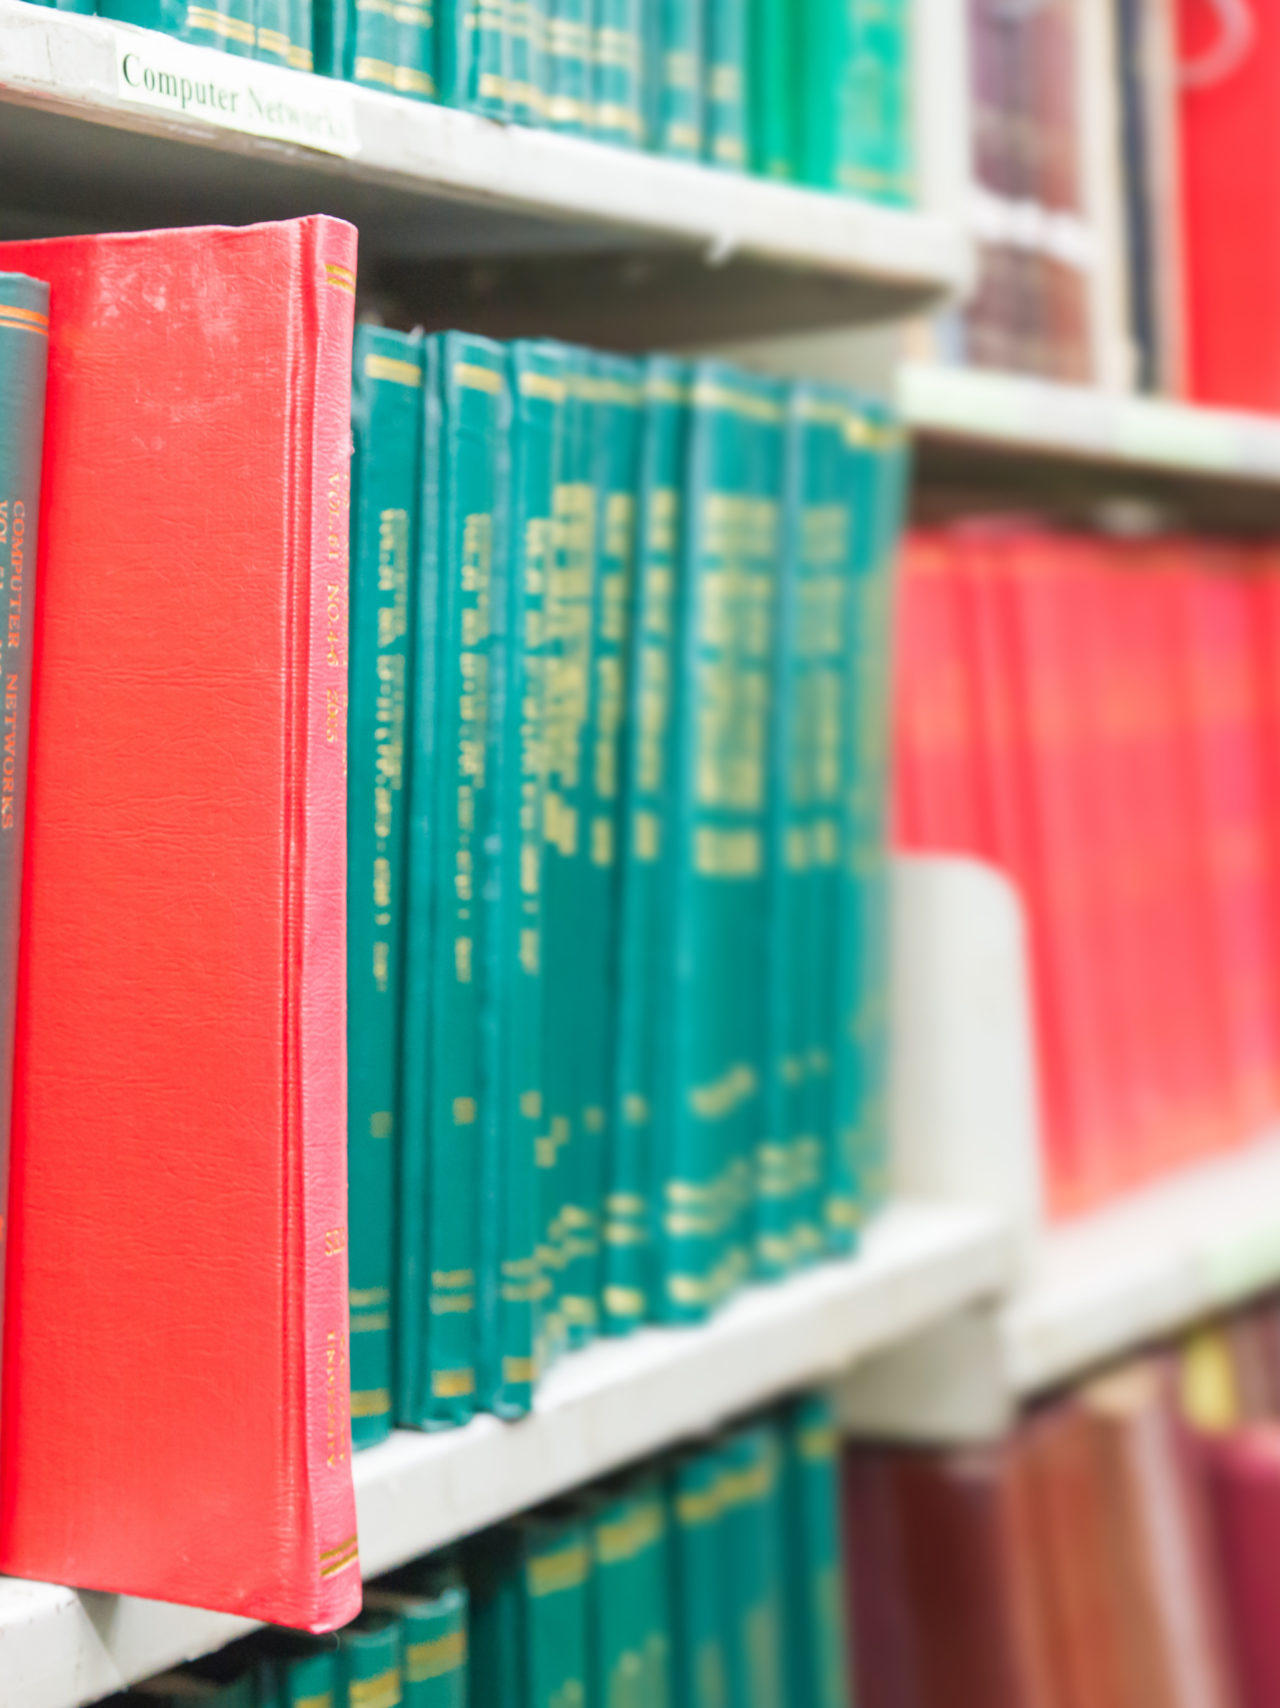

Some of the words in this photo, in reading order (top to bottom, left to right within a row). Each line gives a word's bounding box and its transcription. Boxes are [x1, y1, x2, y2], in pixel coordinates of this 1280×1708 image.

[122, 53, 239, 113] Computer
[8, 500, 25, 648] COMPUTER
[1, 673, 18, 829] NETWORKS
